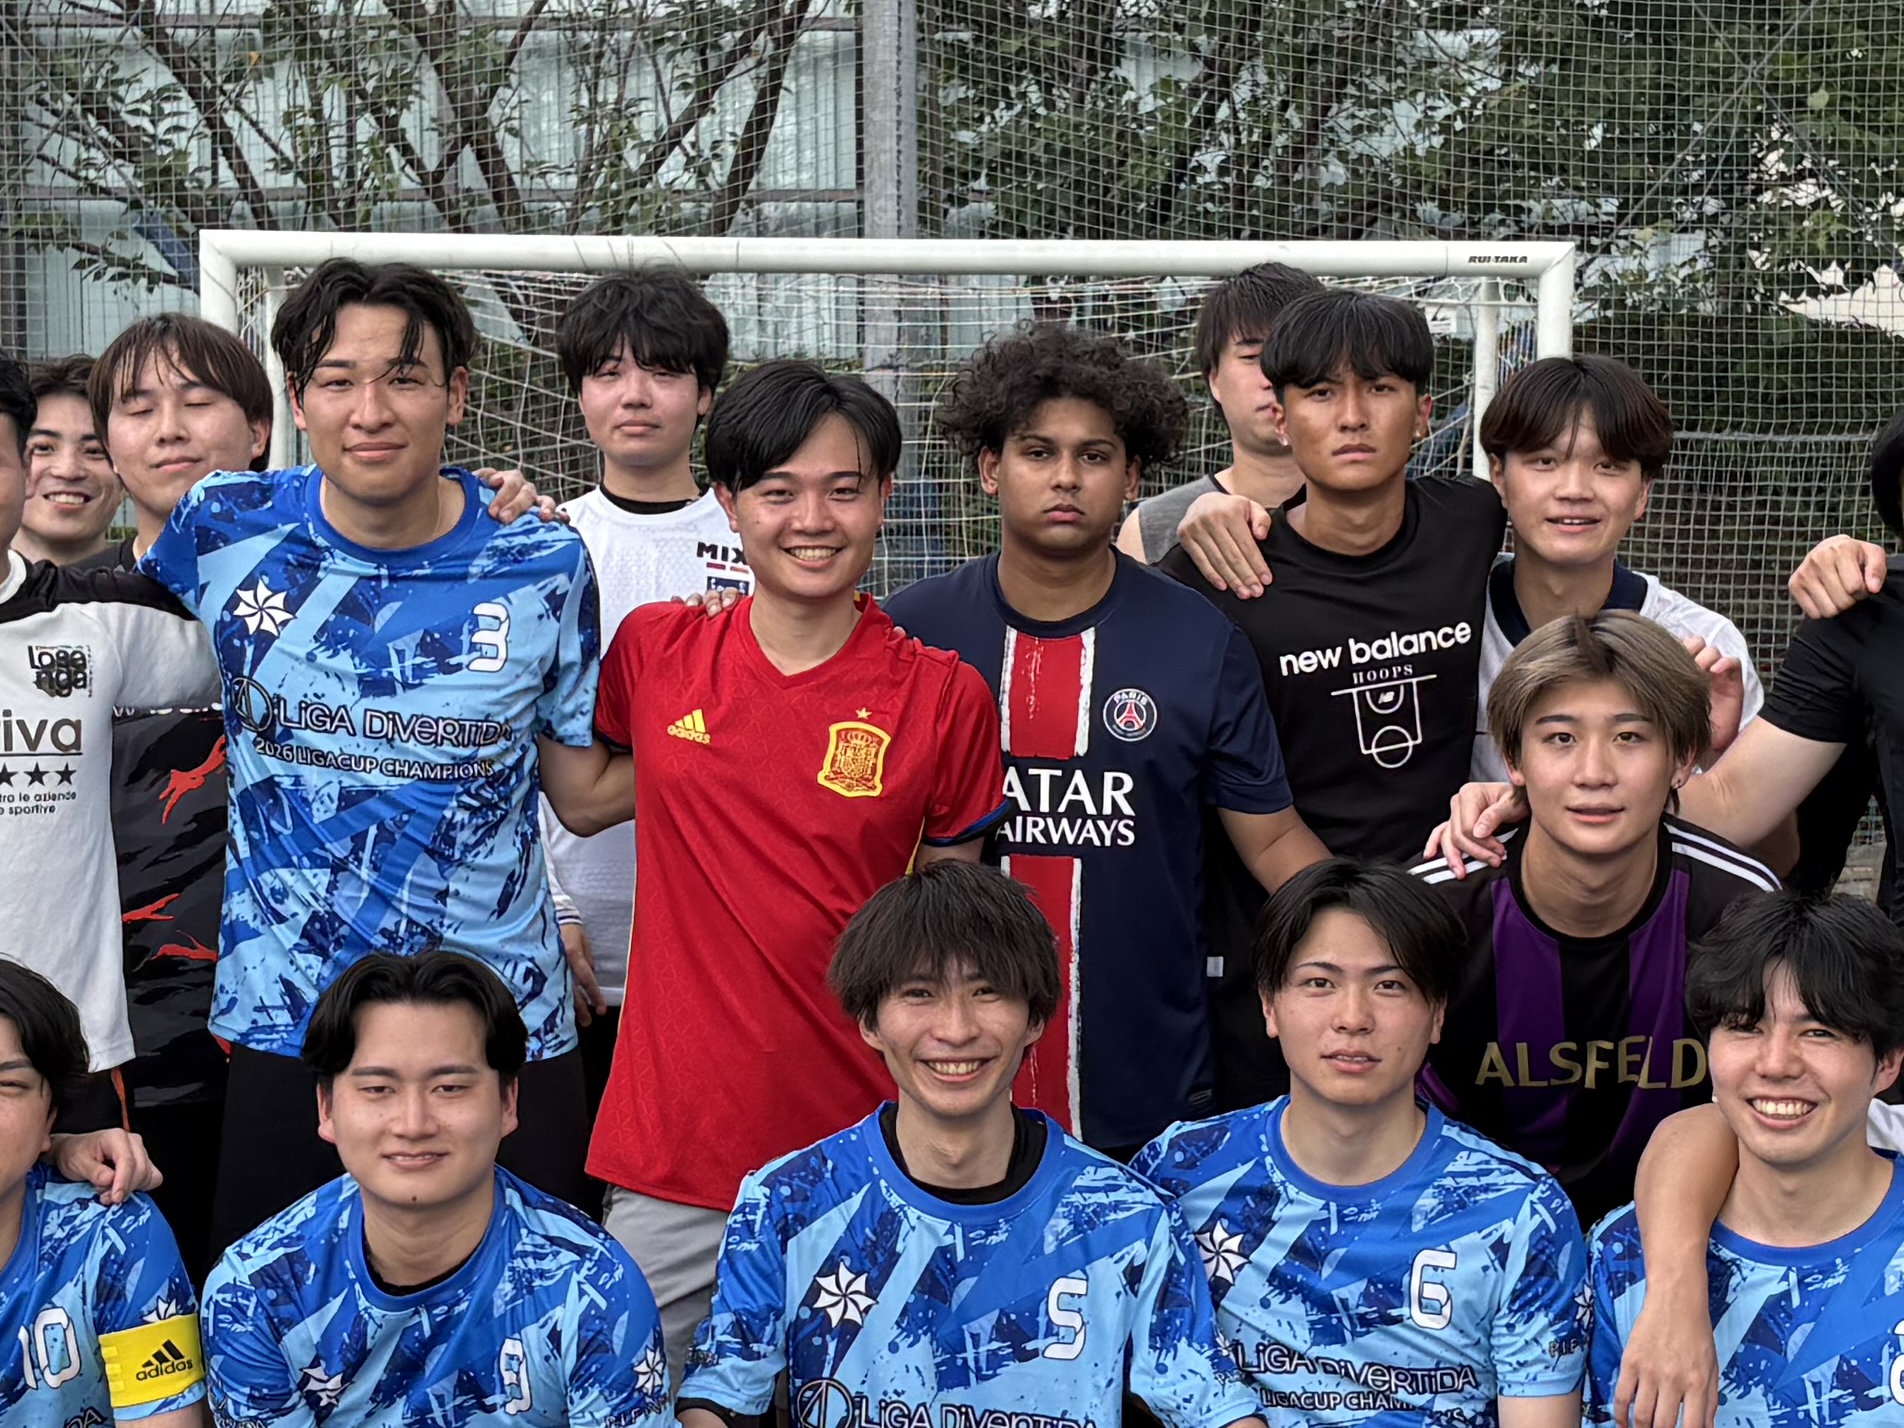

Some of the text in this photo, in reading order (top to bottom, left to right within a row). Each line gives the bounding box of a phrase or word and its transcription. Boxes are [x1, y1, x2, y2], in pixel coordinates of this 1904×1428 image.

[467, 602, 511, 673] 3
[1279, 622, 1472, 676] new balance
[1353, 664, 1413, 685] HOOPS
[256, 738, 495, 780] 2026 LIGACUP CHAMPIONS
[1002, 766, 1136, 816] ATAR
[995, 816, 1136, 847] AIRWAYS
[1475, 1035, 1707, 1089] ALSFELD
[1411, 1250, 1456, 1329] 6
[18, 1306, 82, 1391] 10
[136, 1359, 193, 1381] adidas
[1262, 1390, 1340, 1411] LIGACUP
